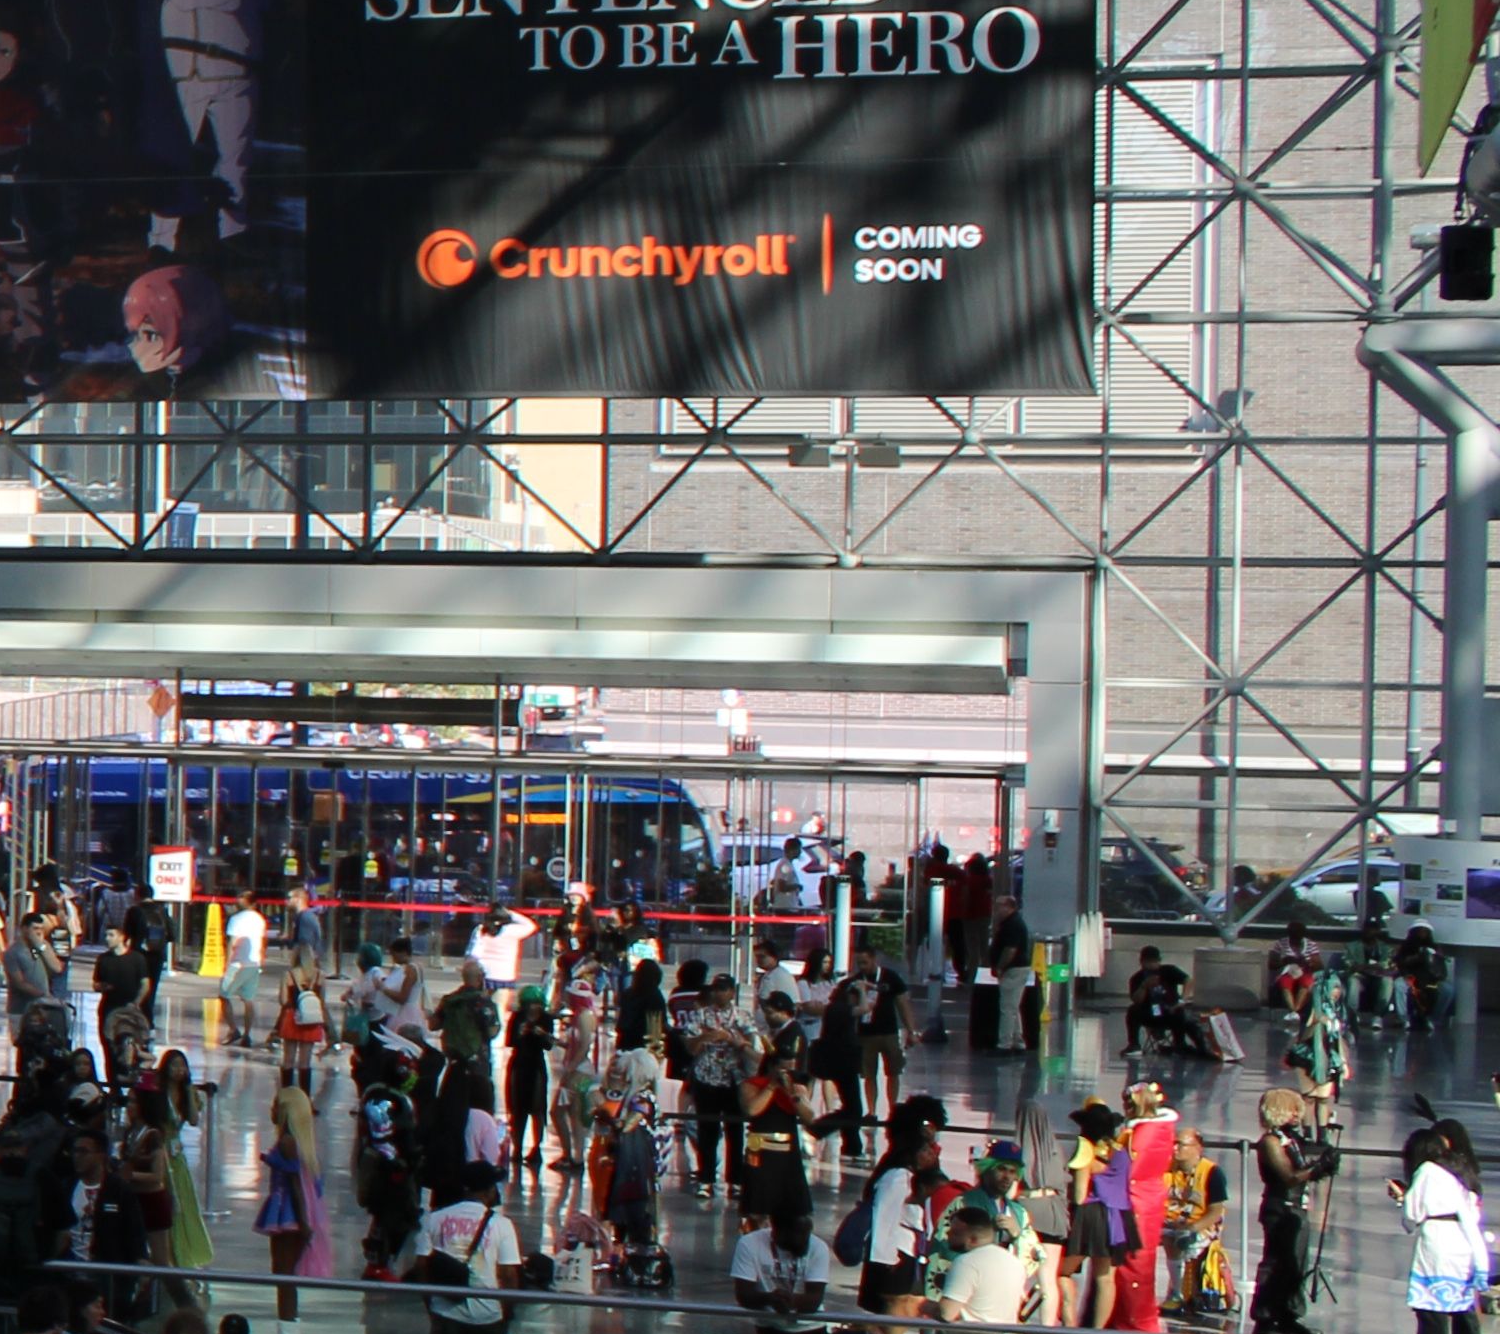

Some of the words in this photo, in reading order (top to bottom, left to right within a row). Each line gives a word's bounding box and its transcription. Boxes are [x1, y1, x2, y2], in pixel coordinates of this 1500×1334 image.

[519, 24, 606, 73] TO
[619, 22, 698, 69] BE
[710, 19, 759, 66] A
[772, 5, 1042, 80] HERO
[854, 223, 984, 251] COMING
[488, 232, 789, 287] Crunchyroll
[854, 256, 945, 283] SOON
[155, 875, 185, 885] ONLY
